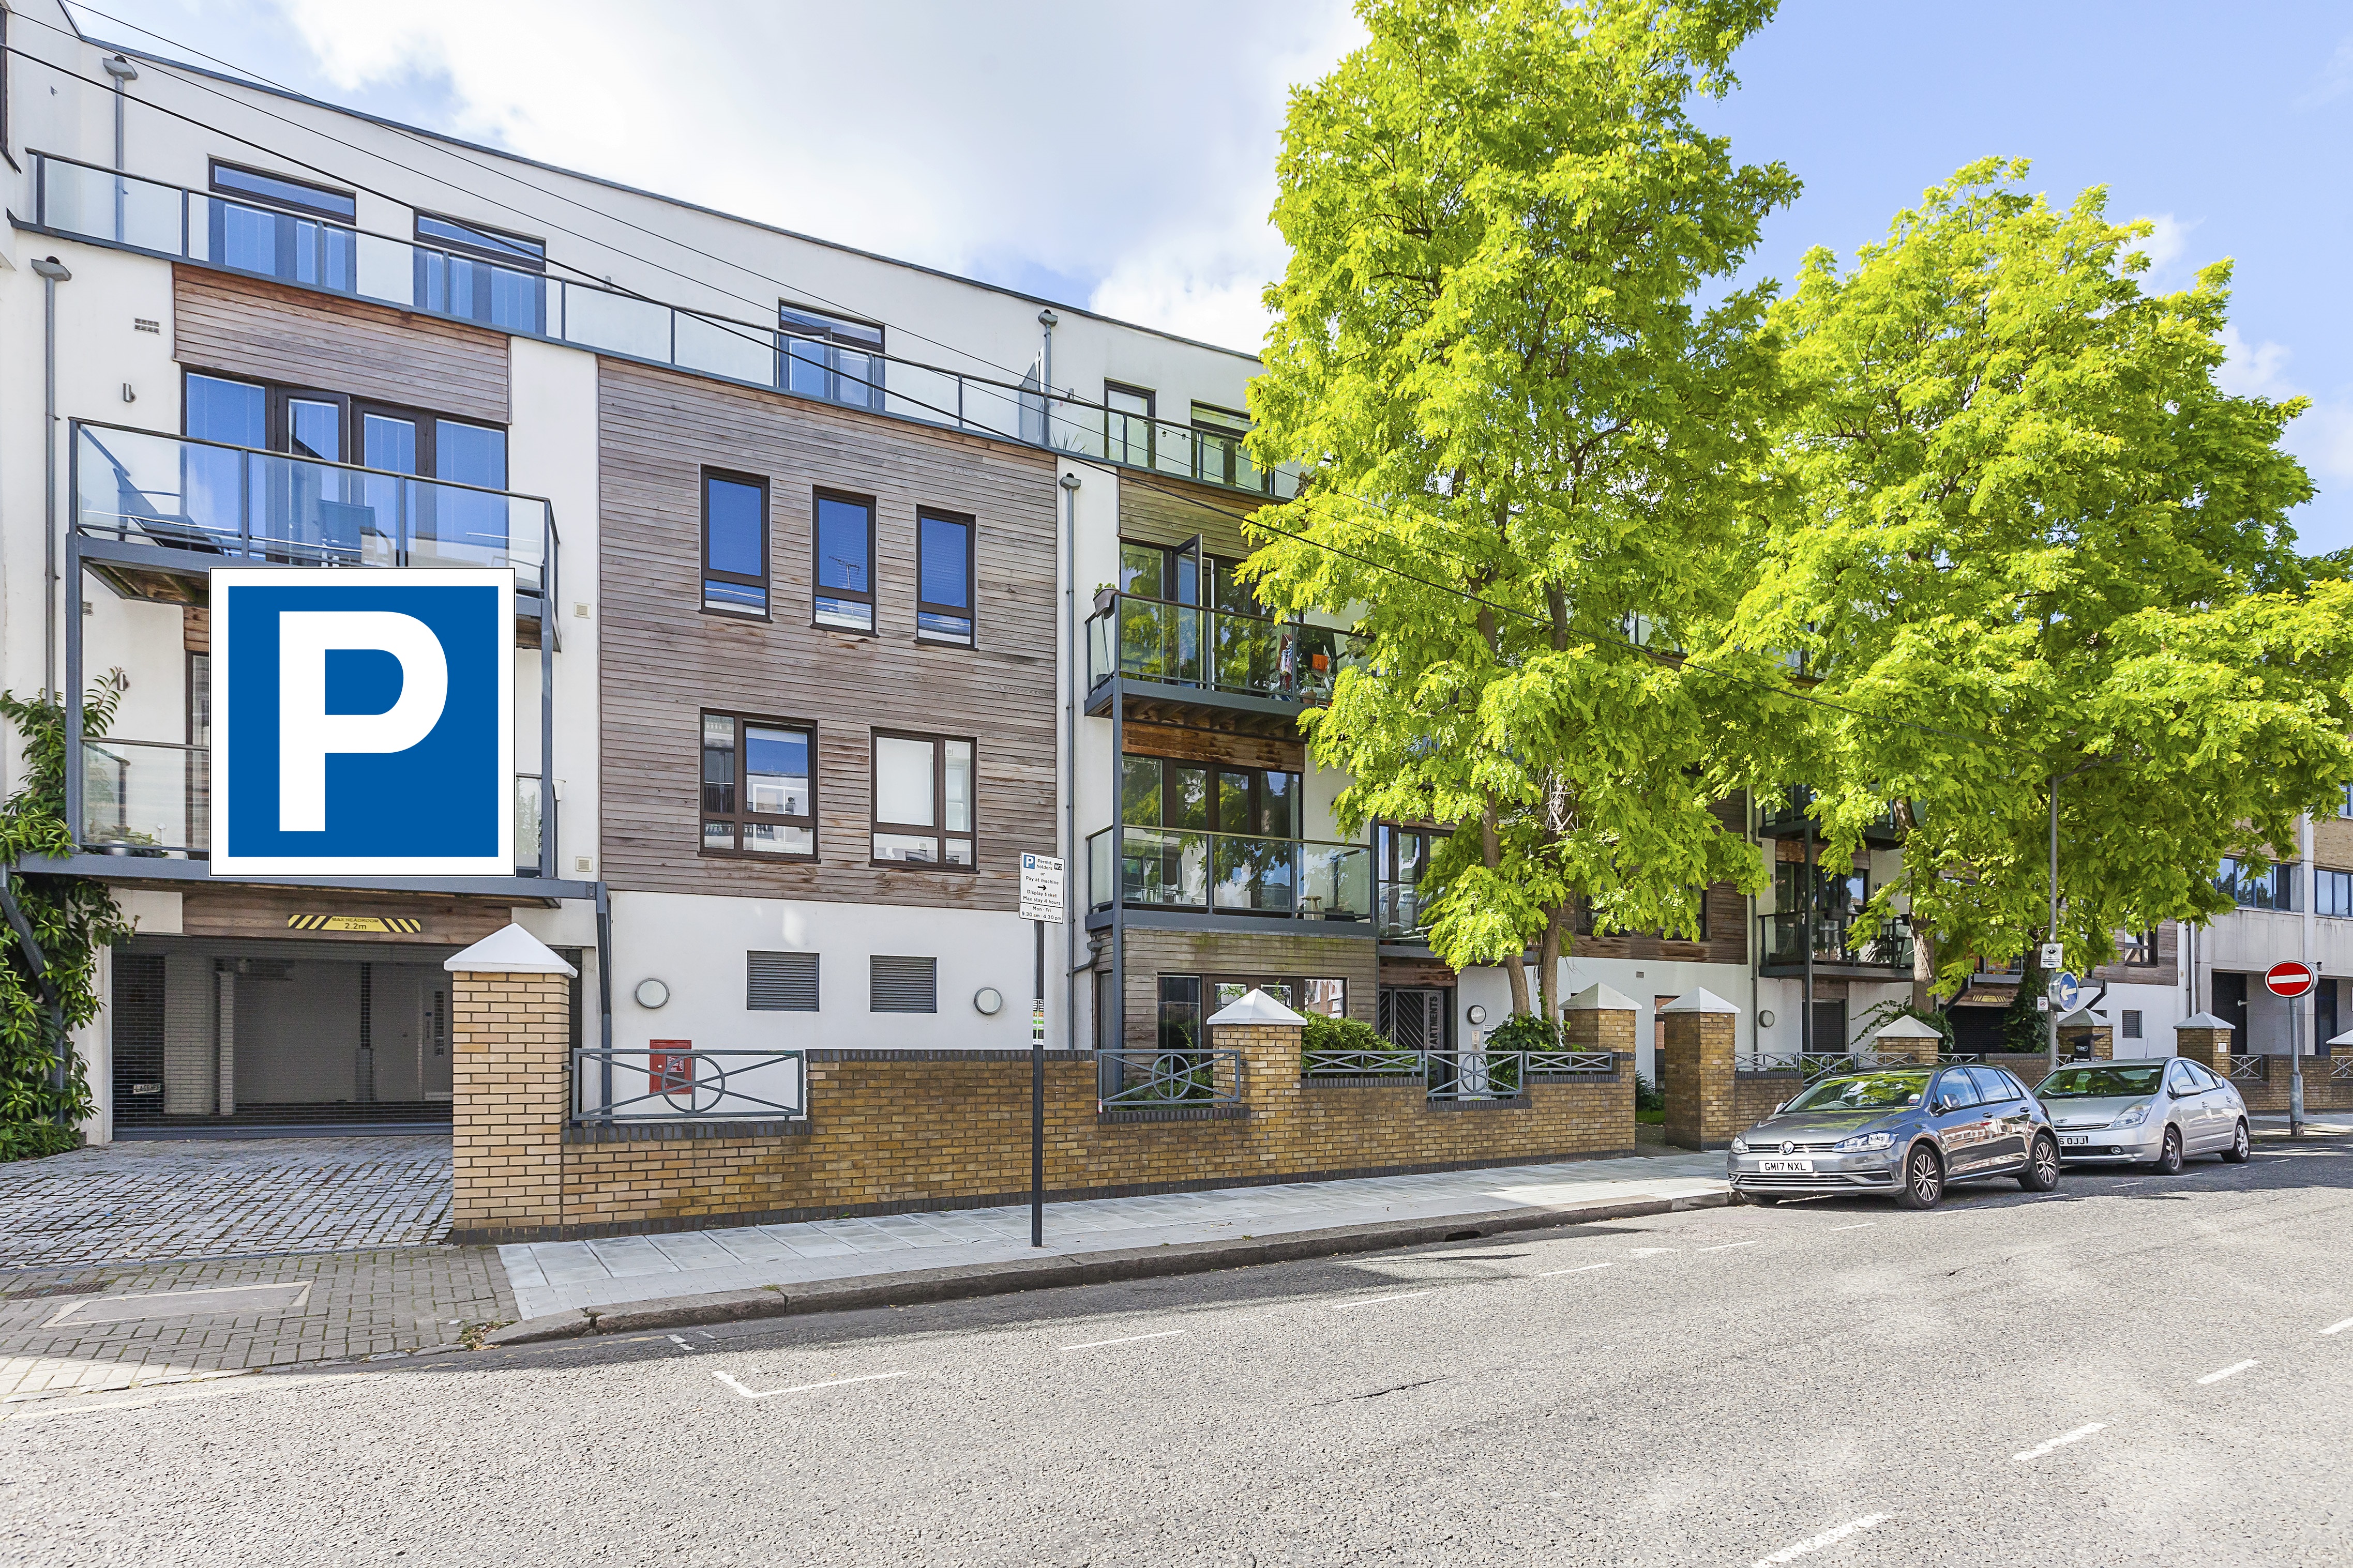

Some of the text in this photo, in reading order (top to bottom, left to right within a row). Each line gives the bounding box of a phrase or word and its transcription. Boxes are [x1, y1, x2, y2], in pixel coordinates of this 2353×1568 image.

[1026, 856, 1034, 867] P
[1429, 996, 1438, 1055] PARTMENTS
[1764, 1162, 1806, 1171] GM17 NXL
